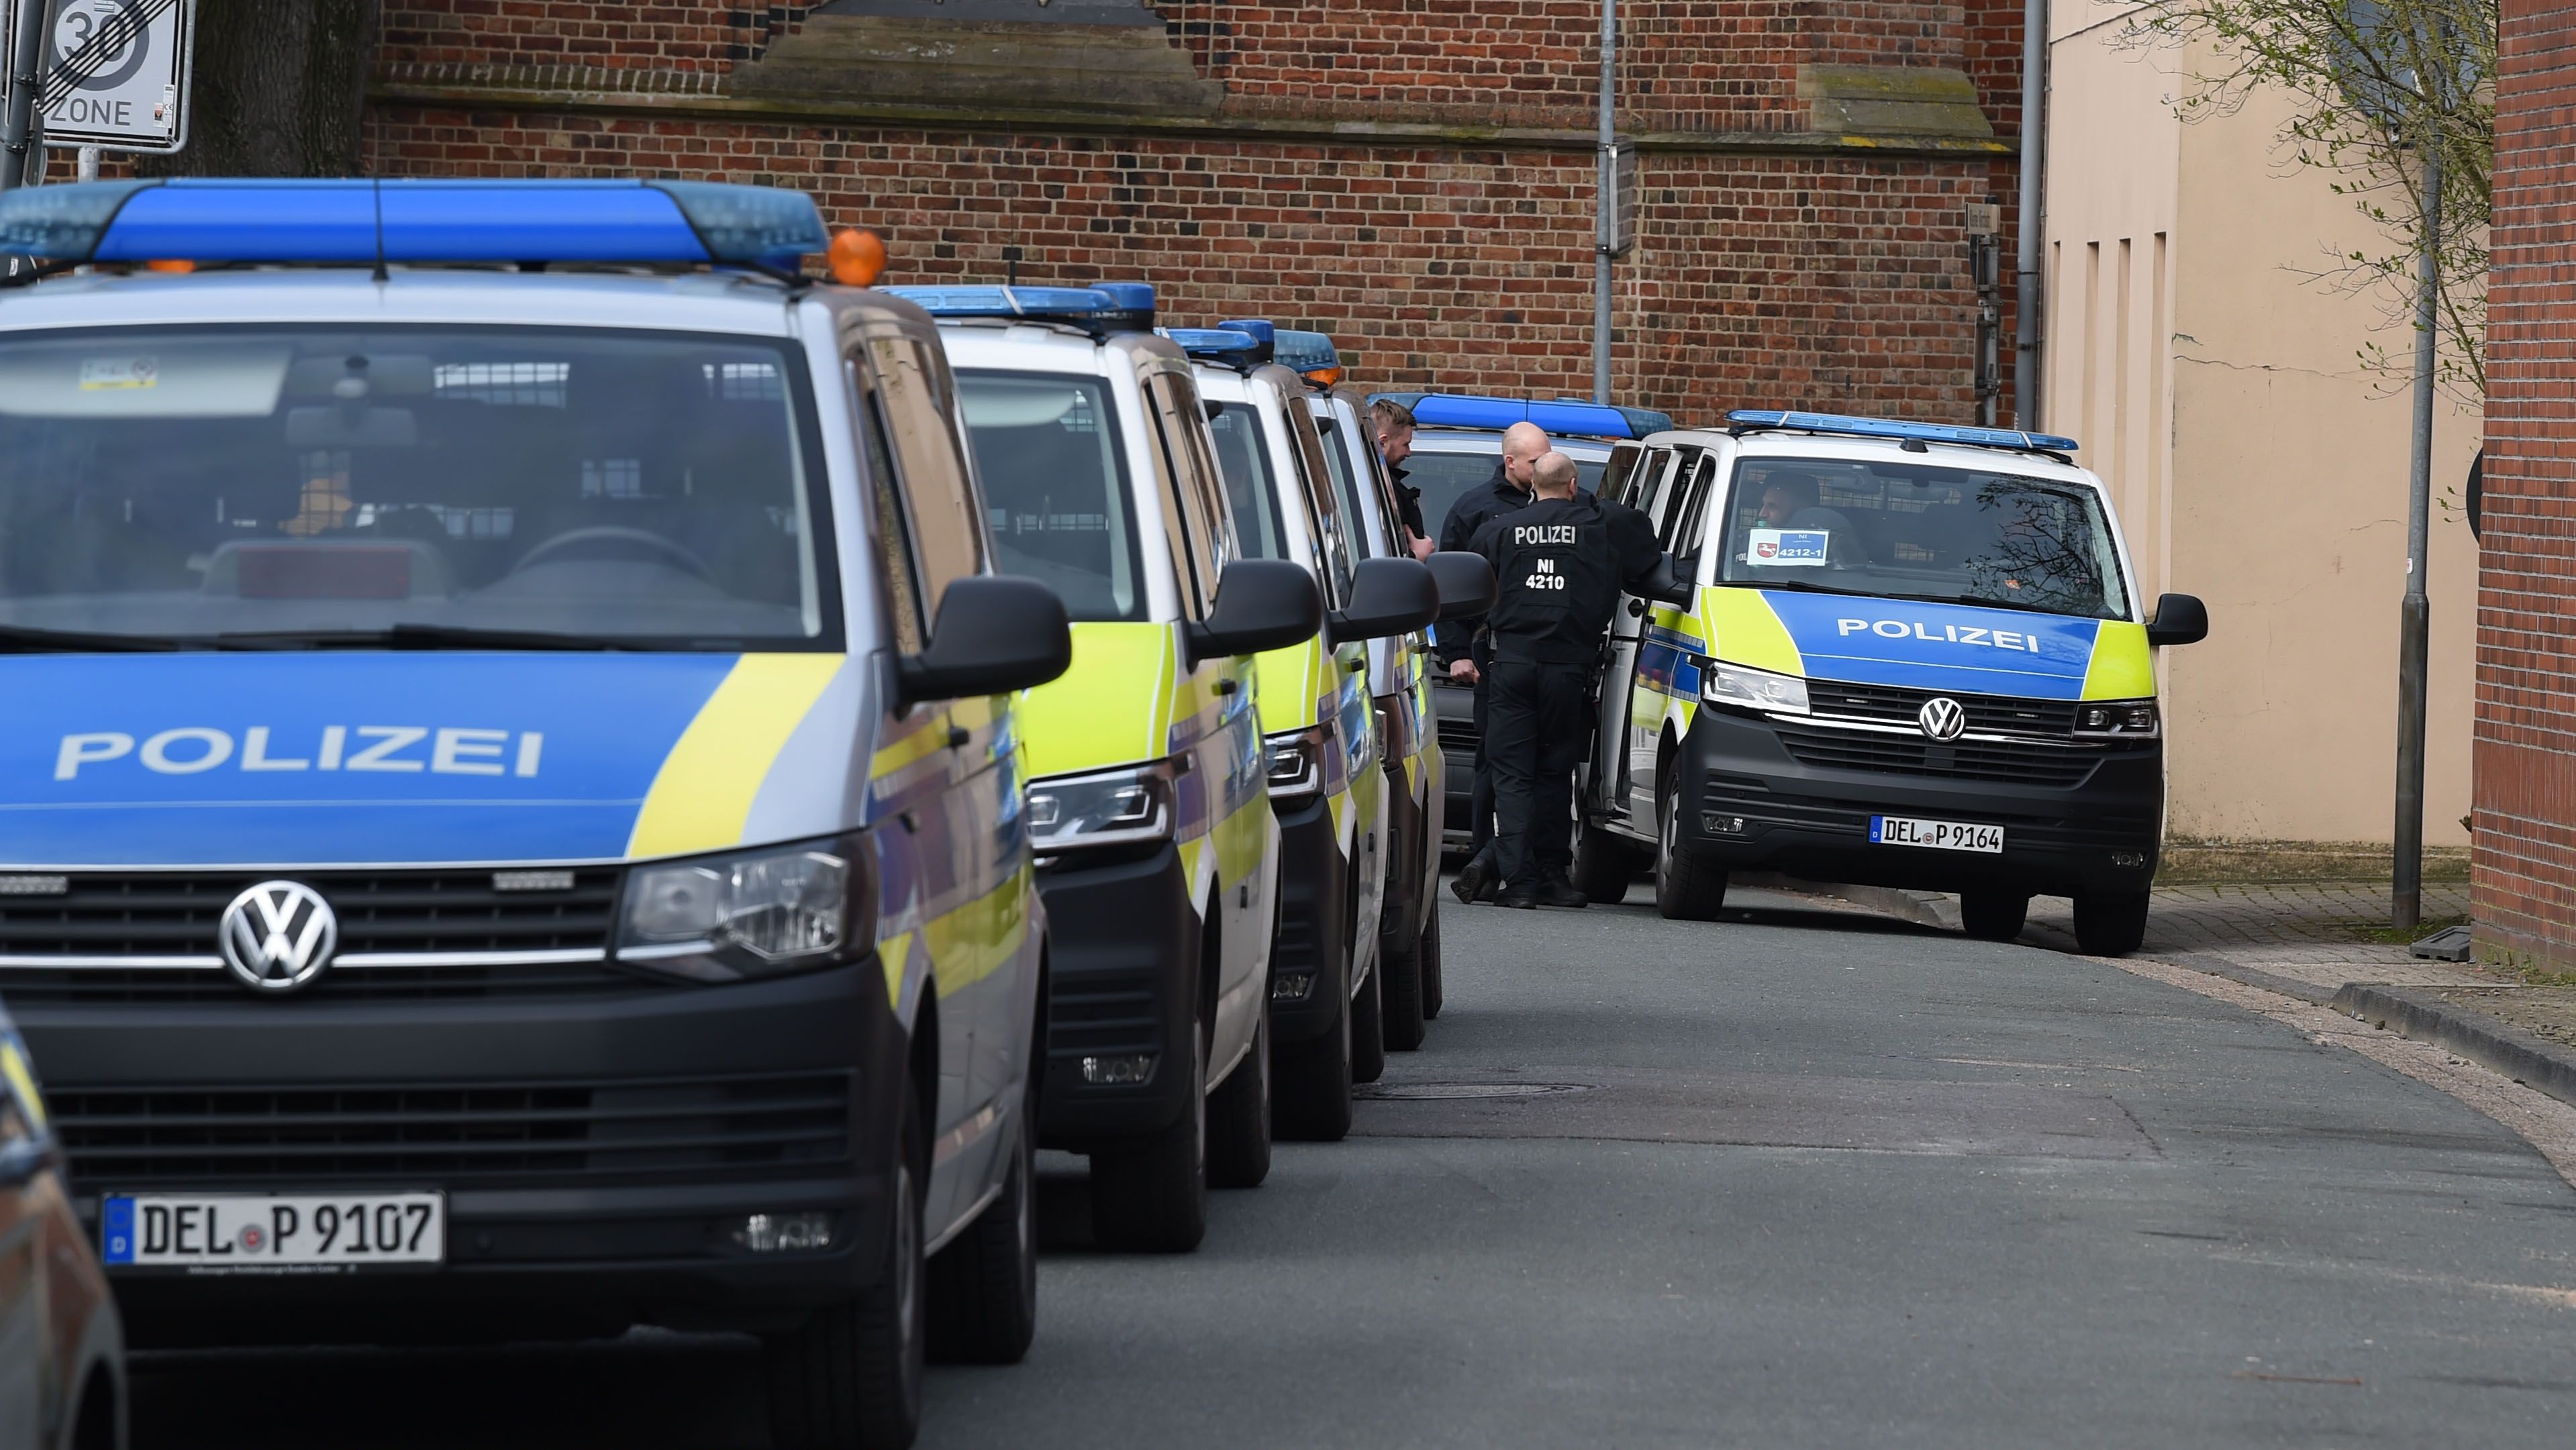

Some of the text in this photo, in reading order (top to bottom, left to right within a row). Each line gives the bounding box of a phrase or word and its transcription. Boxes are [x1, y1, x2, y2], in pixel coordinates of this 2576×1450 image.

[64, 11, 126, 62] 30
[50, 97, 132, 126] ZONE
[1515, 525, 1576, 545] POLIZEI
[1537, 558, 1554, 574] NI
[1779, 548, 1821, 557] 4212-1
[1526, 574, 1565, 590] 4210
[1837, 619, 2039, 653] POLIZEI
[54, 725, 544, 781] POLIZEI
[1884, 819, 1921, 843] DEL
[1936, 824, 1948, 845] P
[1953, 826, 1999, 849] 9164
[111, 1203, 433, 1255] D DEL P 9107
